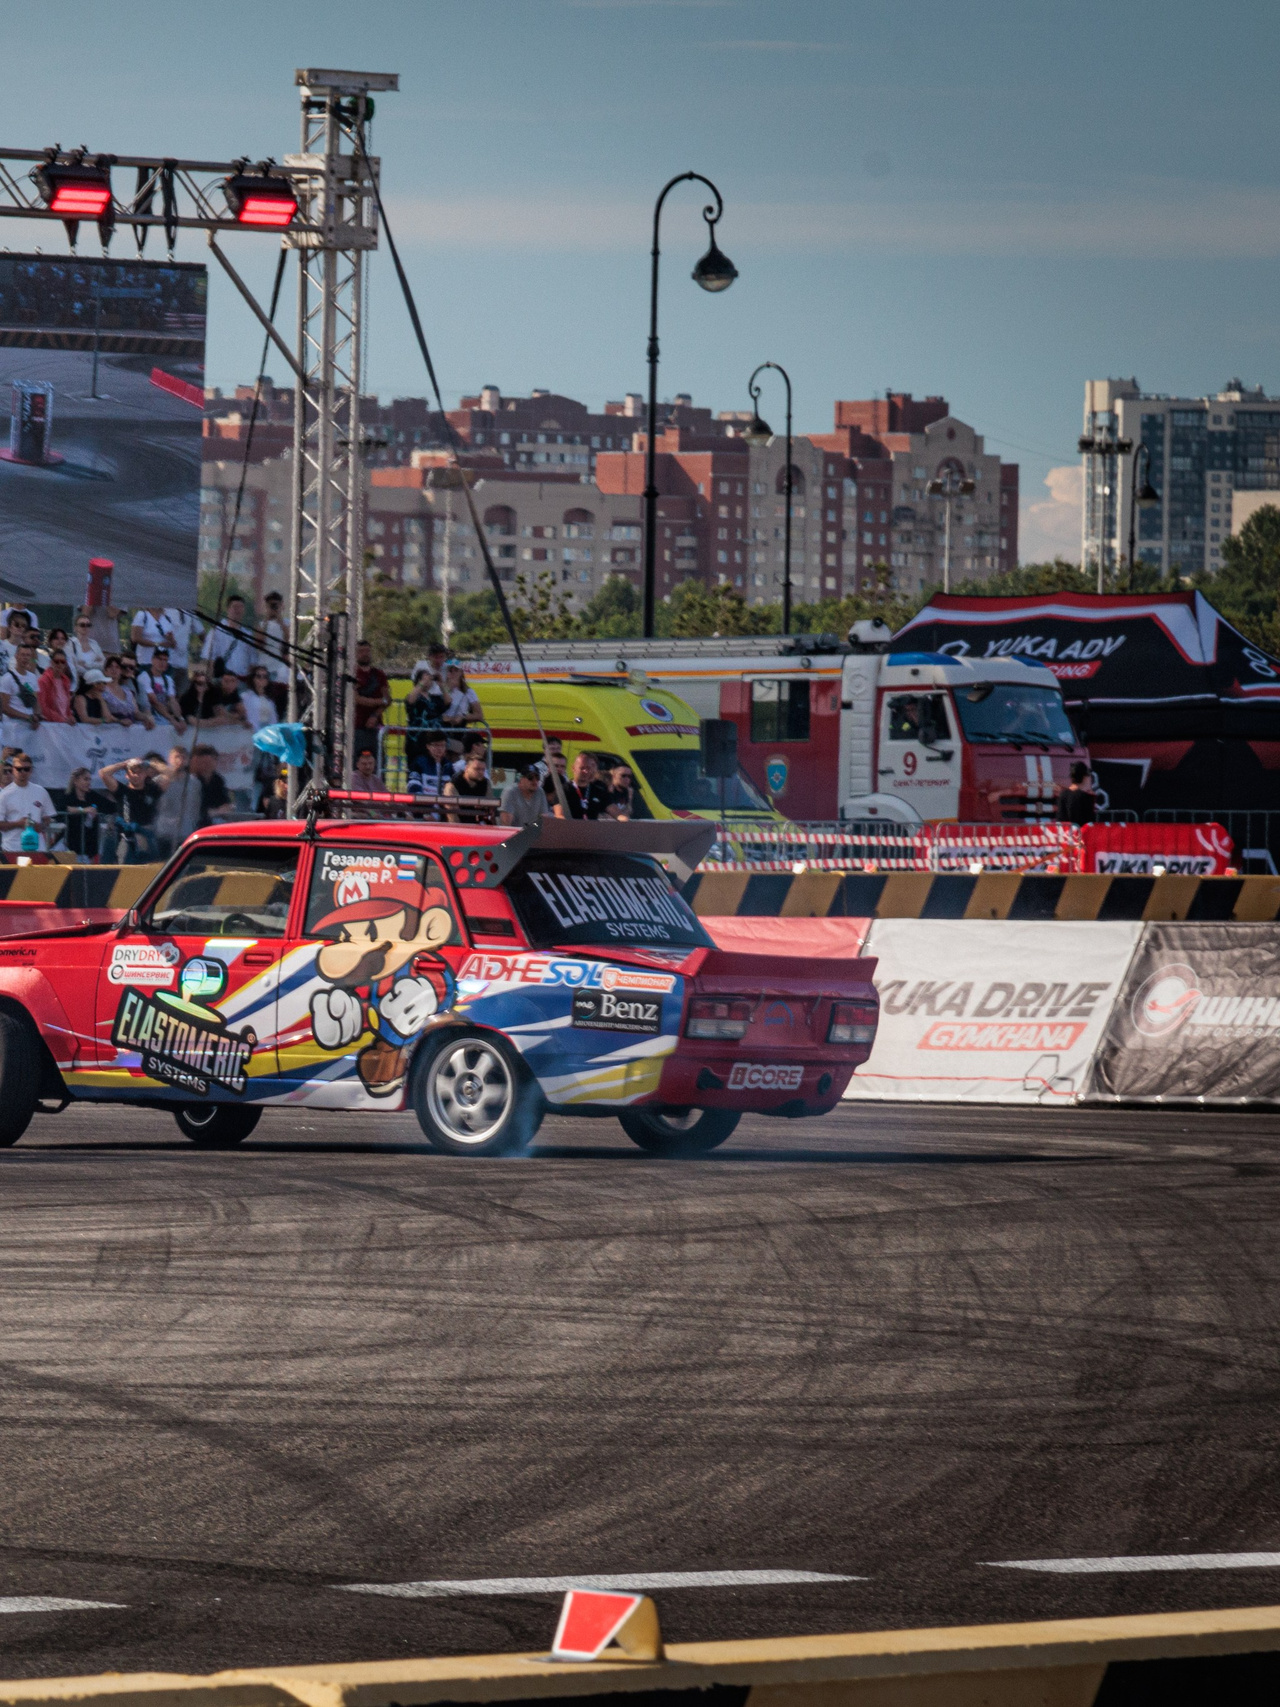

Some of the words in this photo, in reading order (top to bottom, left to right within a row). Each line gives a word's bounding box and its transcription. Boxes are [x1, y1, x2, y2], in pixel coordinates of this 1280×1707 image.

[983, 635, 1060, 657] YUKA
[1059, 635, 1128, 659] ADV
[1048, 664, 1091, 678] CING
[903, 751, 917, 776] 9
[323, 851, 380, 868] Гезалов
[381, 869, 393, 884] Р.
[342, 880, 363, 904] M
[527, 872, 694, 932] ELASTOMERIC
[605, 922, 670, 939] SYSTEMS
[115, 949, 162, 962] DRYDRY
[124, 971, 171, 980] ШИНСЕРВИС
[617, 975, 671, 987] ЧЕМПИОНАТ
[600, 993, 659, 1022] Benz
[972, 982, 1112, 1018] DRIVE
[117, 992, 252, 1093] ELASTOMERIC
[928, 1025, 1076, 1048] GYMKHANA
[148, 1056, 207, 1093] SYSTEMS
